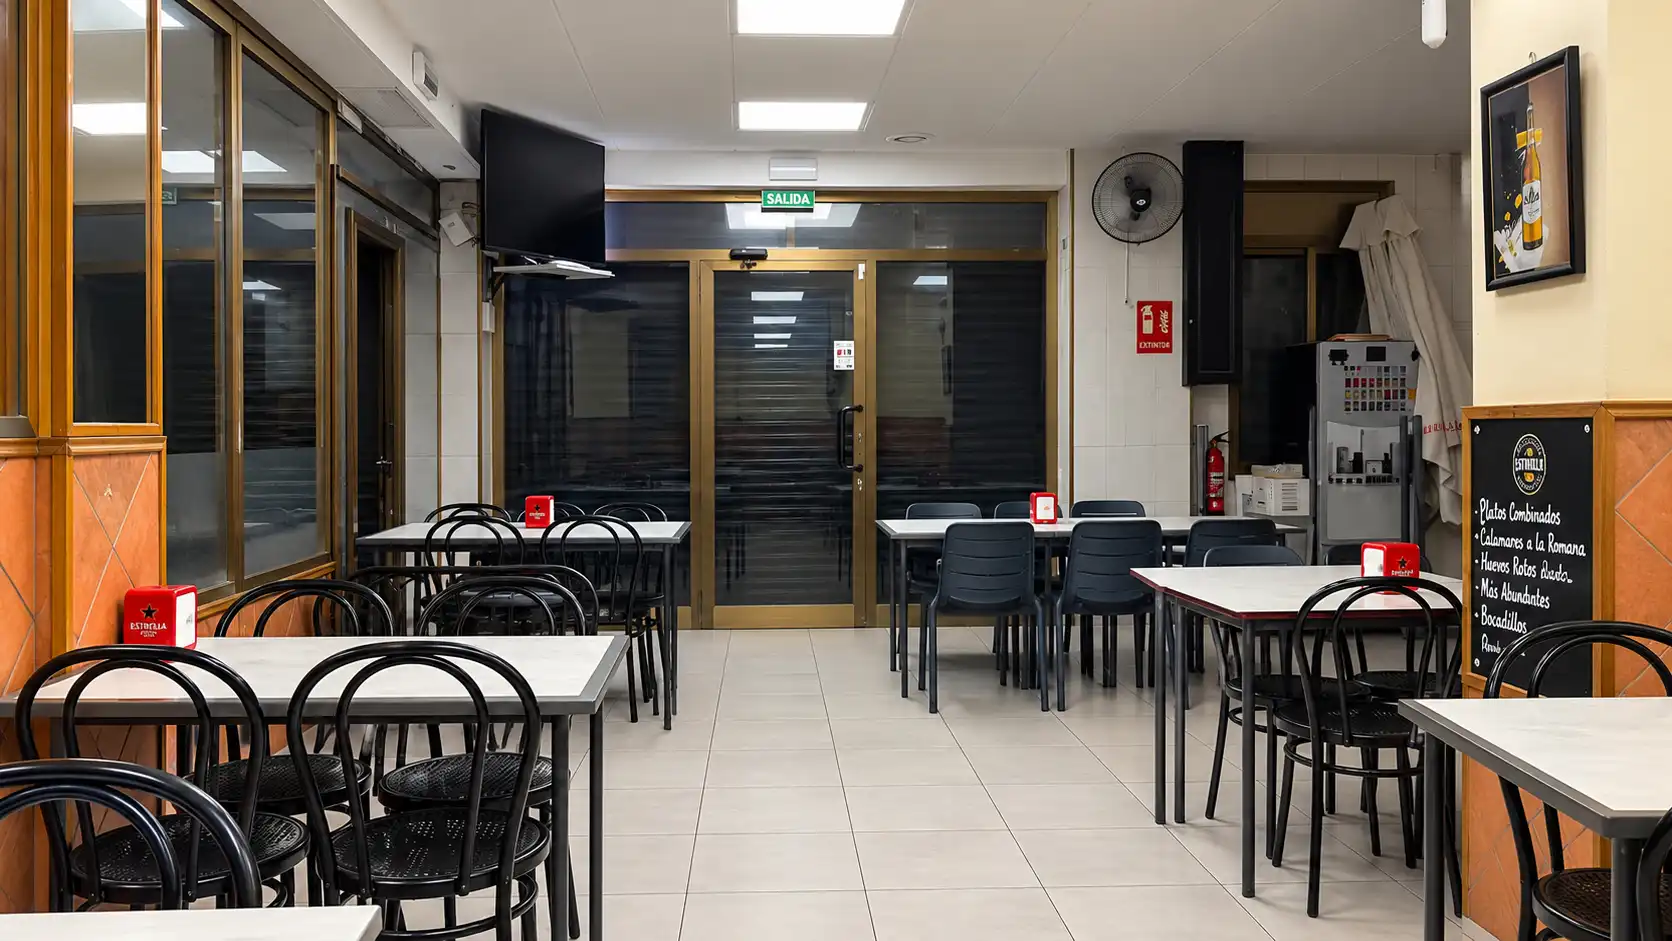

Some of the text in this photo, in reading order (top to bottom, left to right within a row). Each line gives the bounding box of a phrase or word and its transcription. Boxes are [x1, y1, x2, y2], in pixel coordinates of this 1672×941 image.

[767, 193, 810, 205] SALIDA
[1480, 497, 1561, 525] Platos Combinados
[1480, 527, 1587, 557] Calamares a la Romana
[1480, 551, 1510, 574] Huevos
[1512, 556, 1537, 578] Rotos
[1500, 581, 1550, 609] Abundantes
[1481, 604, 1527, 634] Bocadillos
